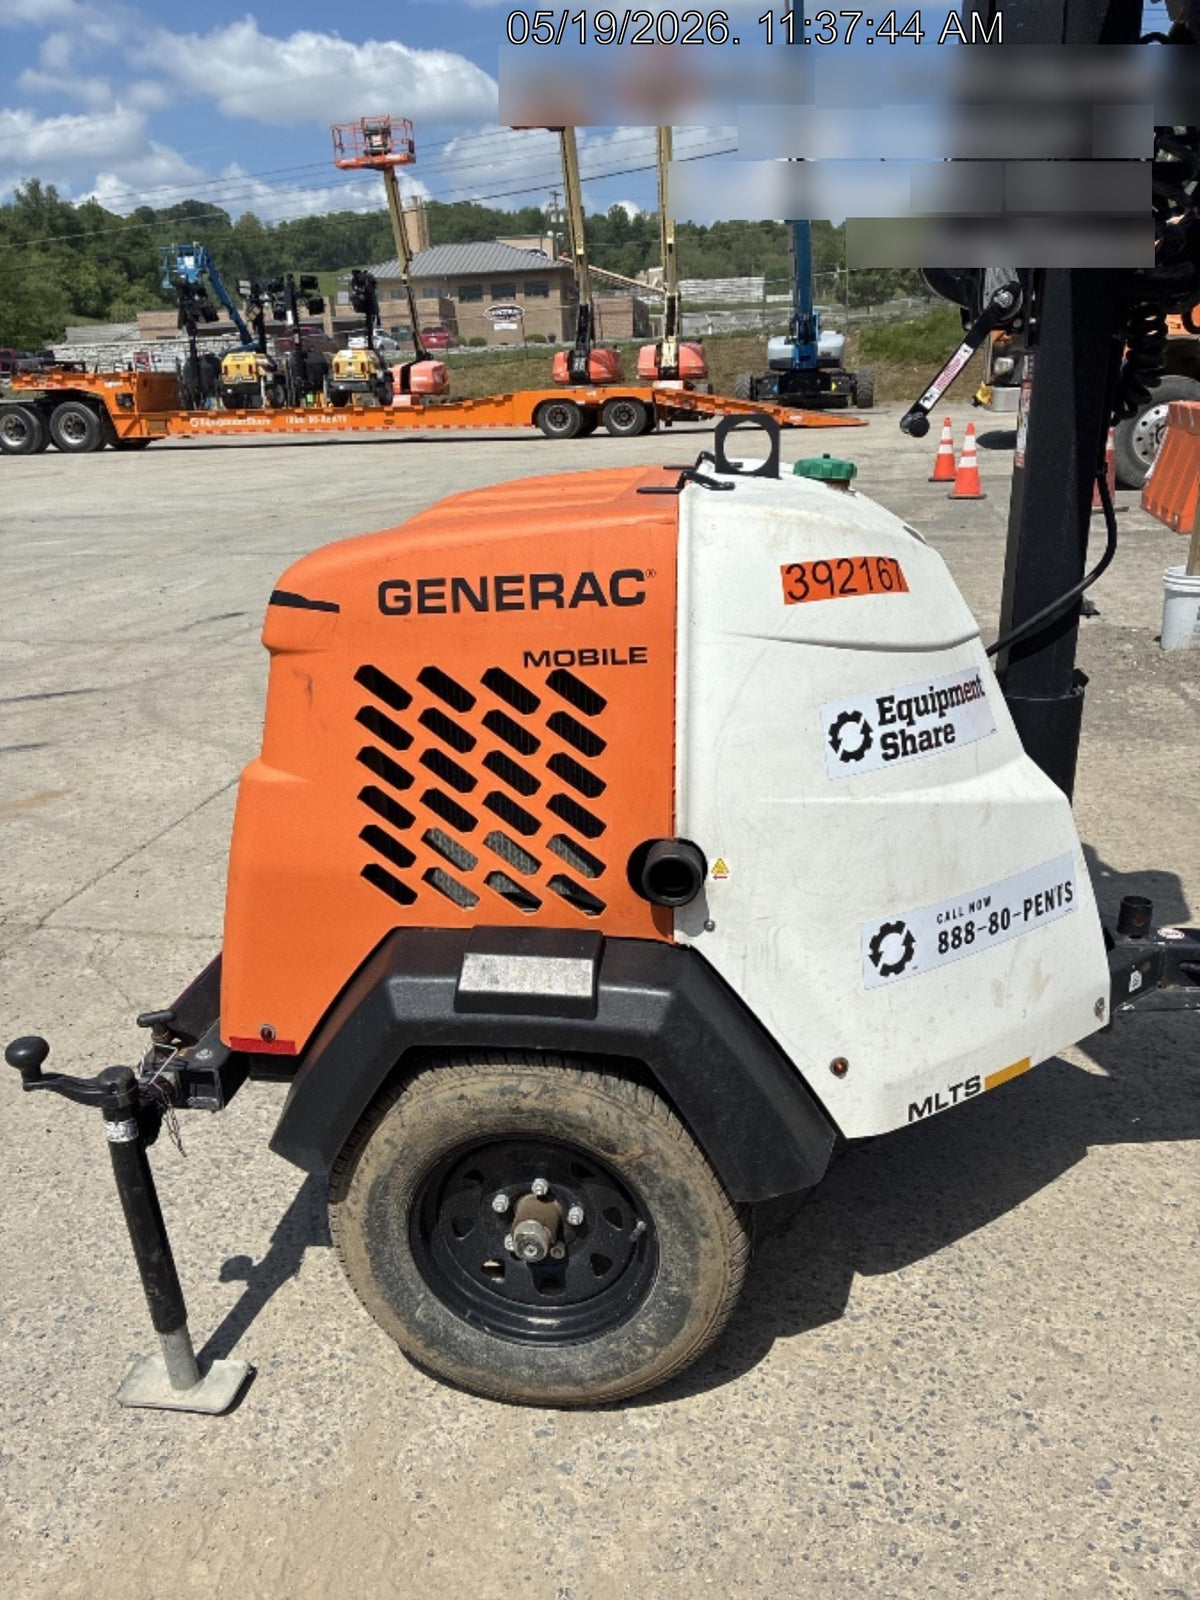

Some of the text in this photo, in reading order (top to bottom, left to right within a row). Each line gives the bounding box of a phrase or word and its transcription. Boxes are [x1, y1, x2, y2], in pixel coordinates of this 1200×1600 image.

[785, 556, 903, 600] 392167
[523, 647, 648, 668] MOBILE
[876, 673, 986, 727] Equipment
[879, 722, 956, 762] Share
[936, 895, 992, 925] CALL NOW
[908, 1074, 982, 1123] MLTS
